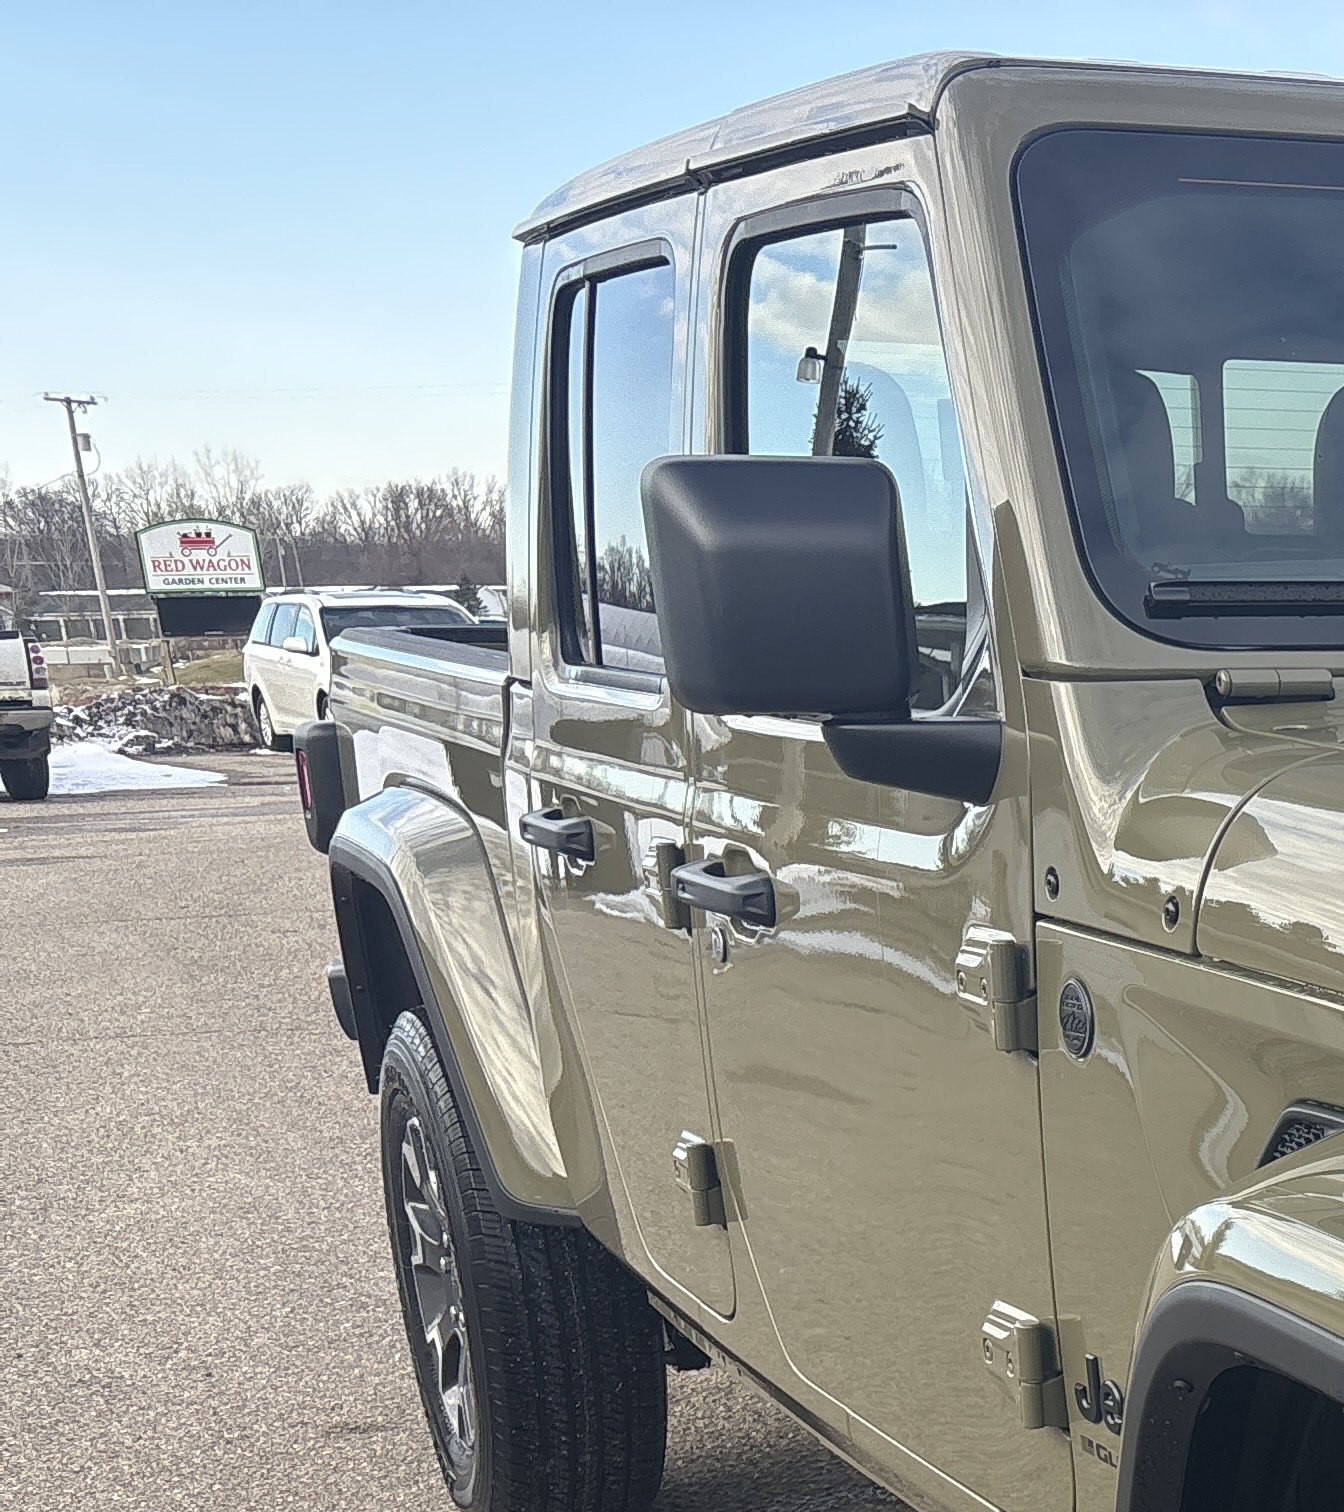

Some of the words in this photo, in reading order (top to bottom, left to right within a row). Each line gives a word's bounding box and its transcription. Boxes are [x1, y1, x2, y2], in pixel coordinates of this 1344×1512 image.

[151, 559, 185, 572] RED
[188, 558, 251, 572] WAGON
[163, 577, 204, 585] GARDEN
[208, 577, 246, 585] CENTER
